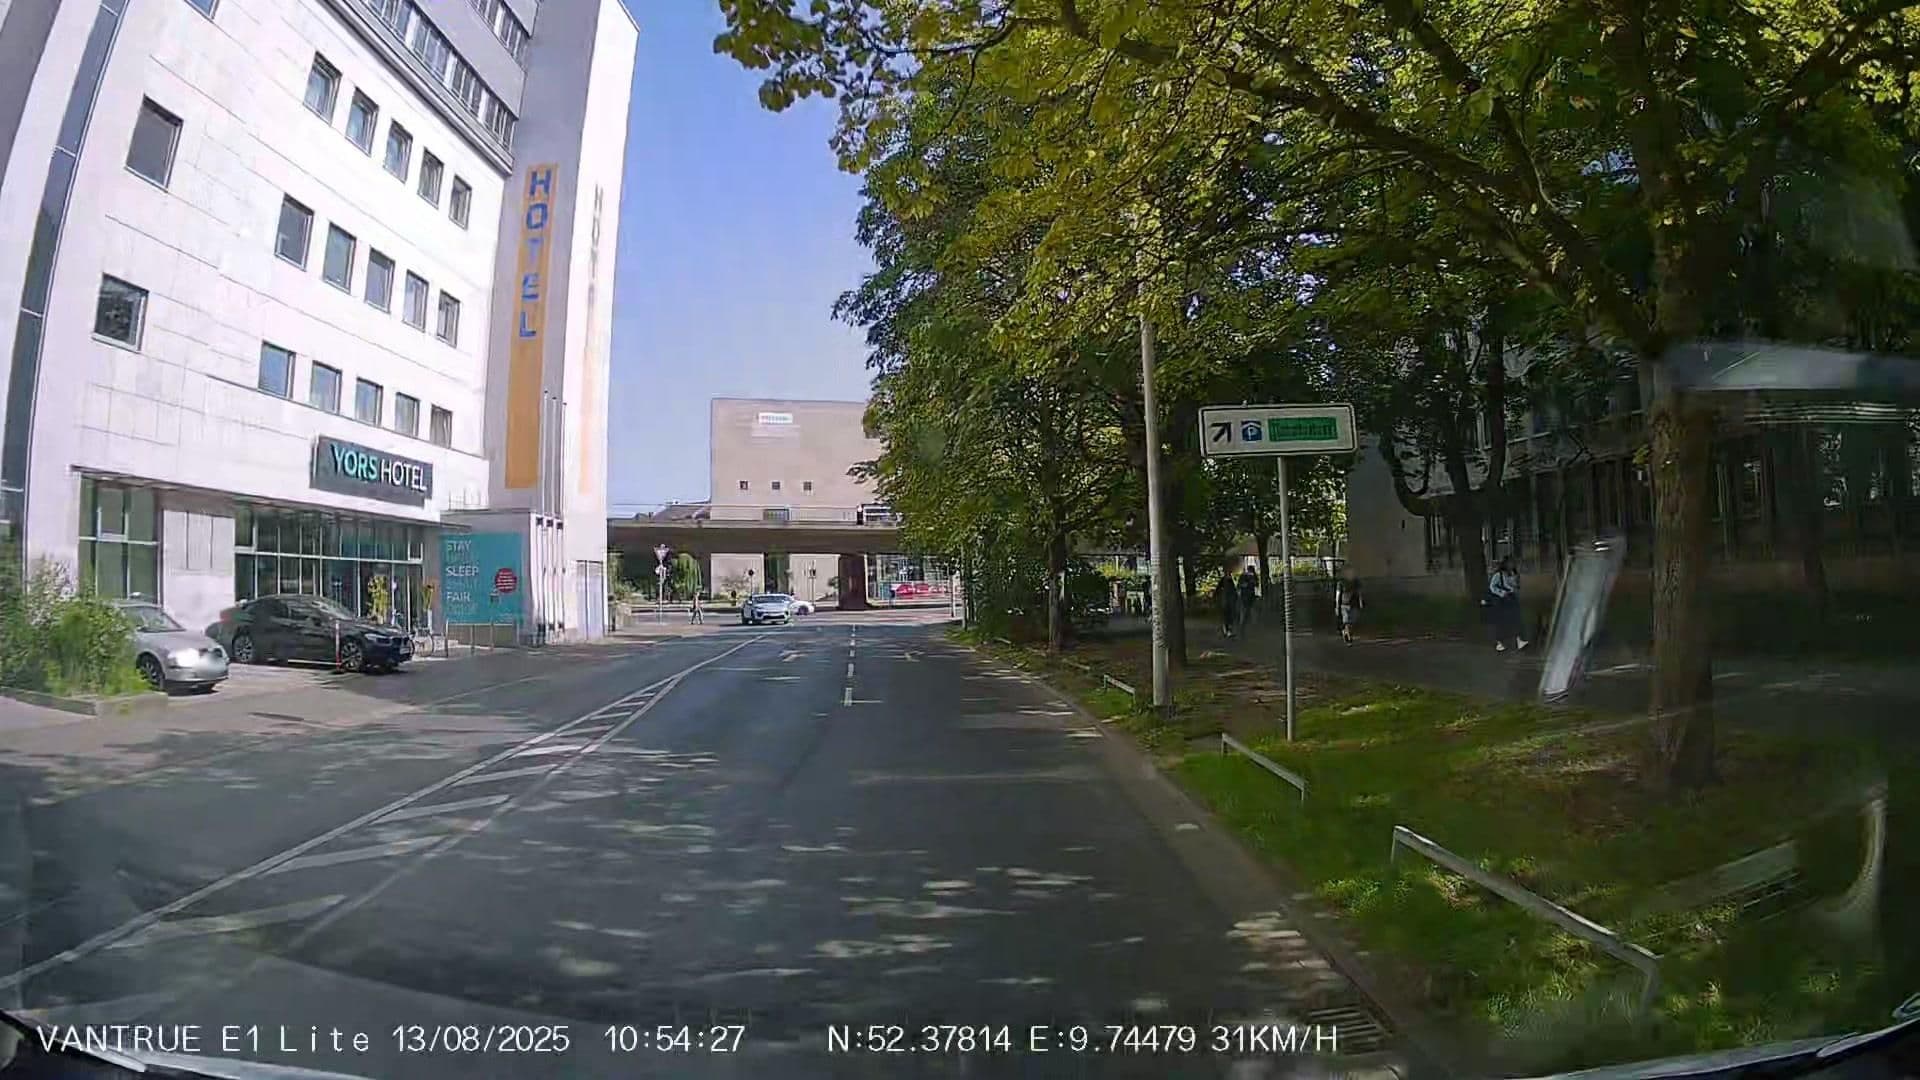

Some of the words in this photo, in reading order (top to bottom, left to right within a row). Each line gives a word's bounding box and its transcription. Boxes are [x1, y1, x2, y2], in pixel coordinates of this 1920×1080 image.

[519, 169, 554, 338] HOTEL
[330, 443, 378, 481] YORS
[380, 458, 428, 492] HOTEL
[446, 540, 472, 553] STAY
[445, 565, 479, 577] SLEEP
[446, 591, 472, 602] FAIR
